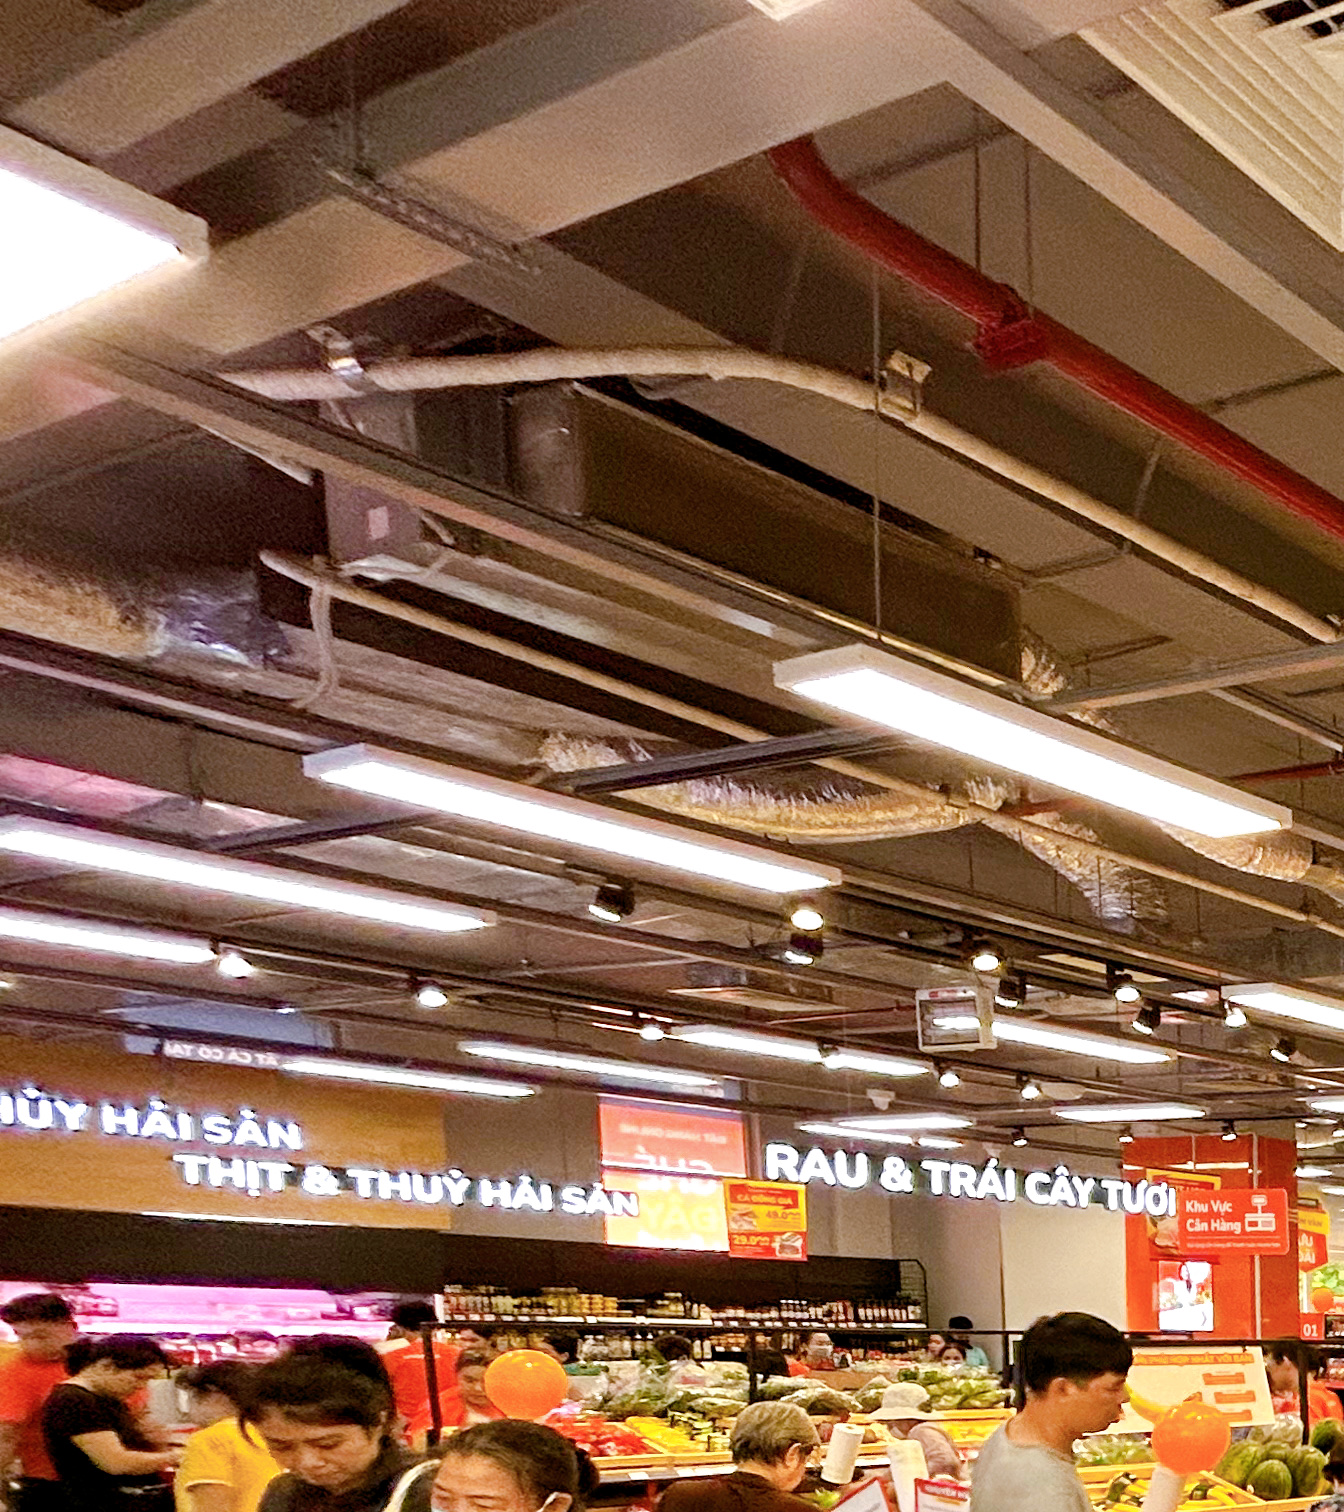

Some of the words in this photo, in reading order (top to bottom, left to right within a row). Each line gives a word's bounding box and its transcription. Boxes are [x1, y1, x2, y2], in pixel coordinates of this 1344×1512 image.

[102, 1094, 193, 1141] HẢI
[203, 1108, 303, 1151] SẢN
[172, 1153, 295, 1197] THỊT
[302, 1164, 340, 1196] &
[346, 1167, 472, 1207] THUỶ
[479, 1175, 554, 1211] HẢI
[561, 1183, 640, 1217] SẢN
[765, 1142, 869, 1189] RAU
[880, 1155, 913, 1193] &
[920, 1157, 1017, 1202] TRÁI
[1025, 1165, 1095, 1208] CÂY
[1101, 1178, 1177, 1216] TƯƠI
[1185, 1200, 1209, 1213] Khu
[1210, 1200, 1233, 1216] Vực
[1186, 1219, 1209, 1233] Cân
[1211, 1217, 1242, 1235] Hàng
[1303, 1324, 1319, 1337] 01
